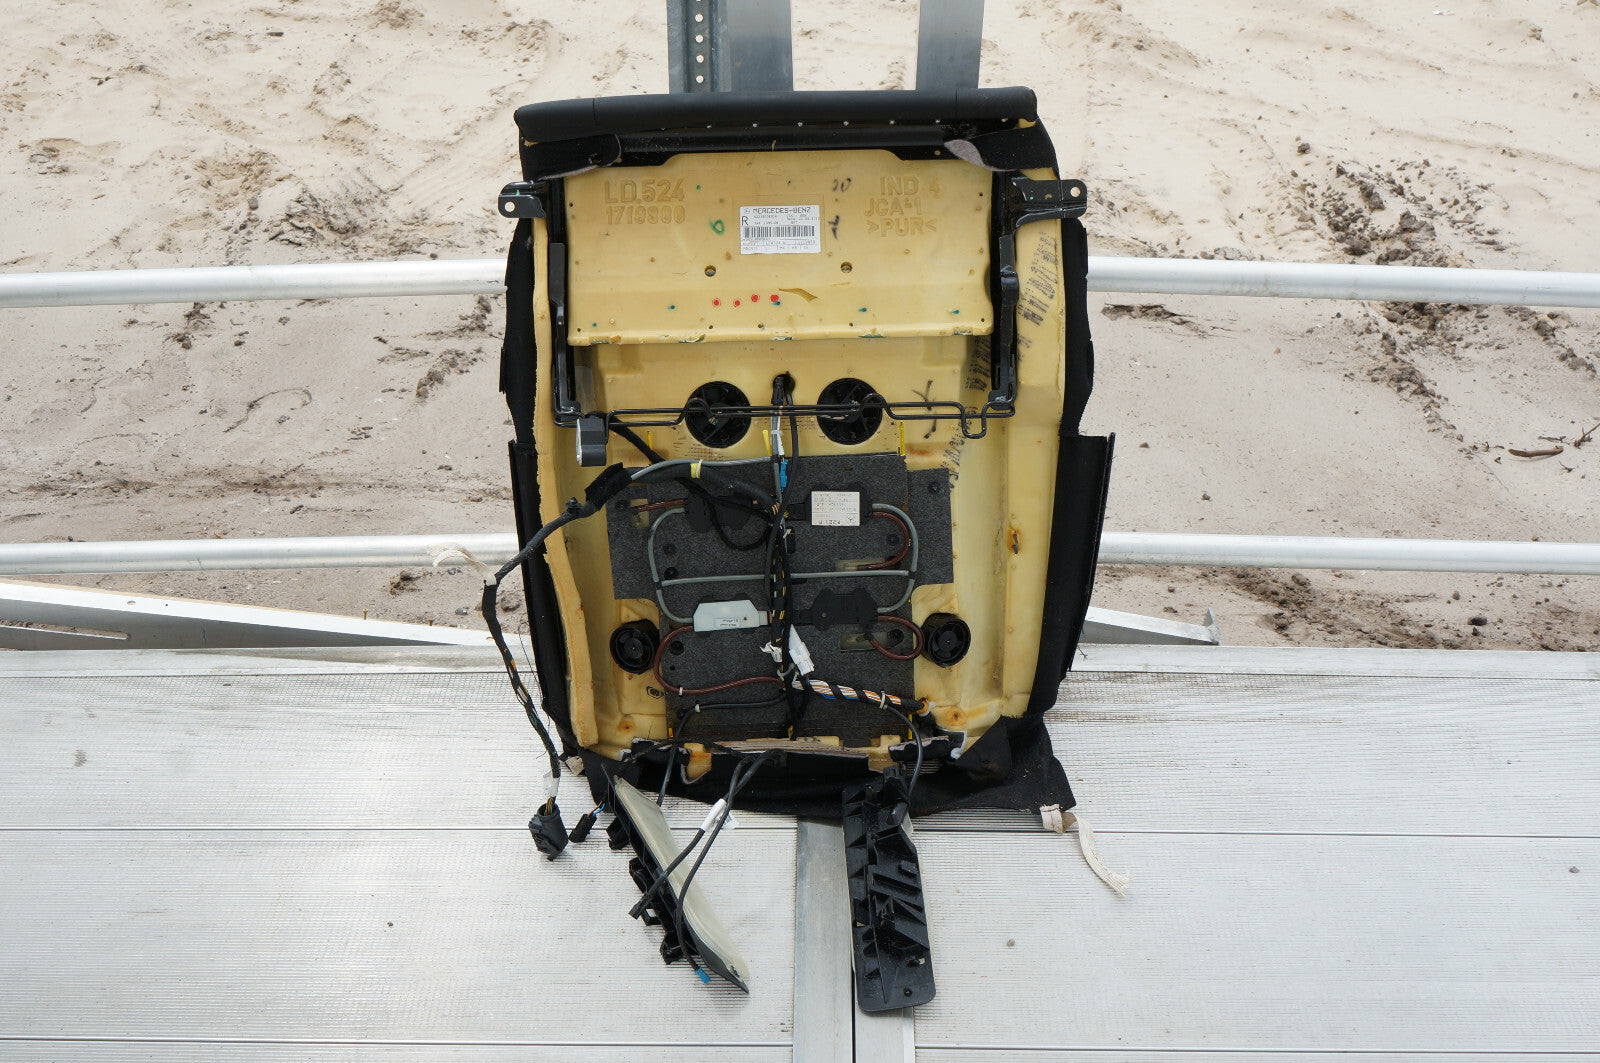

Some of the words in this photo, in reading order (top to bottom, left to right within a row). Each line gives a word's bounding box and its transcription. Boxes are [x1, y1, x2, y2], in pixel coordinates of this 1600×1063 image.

[604, 178, 685, 204] LD.524
[880, 175, 919, 196] IND
[753, 206, 811, 214] MERCEDES-BENZ
[741, 215, 749, 226] R
